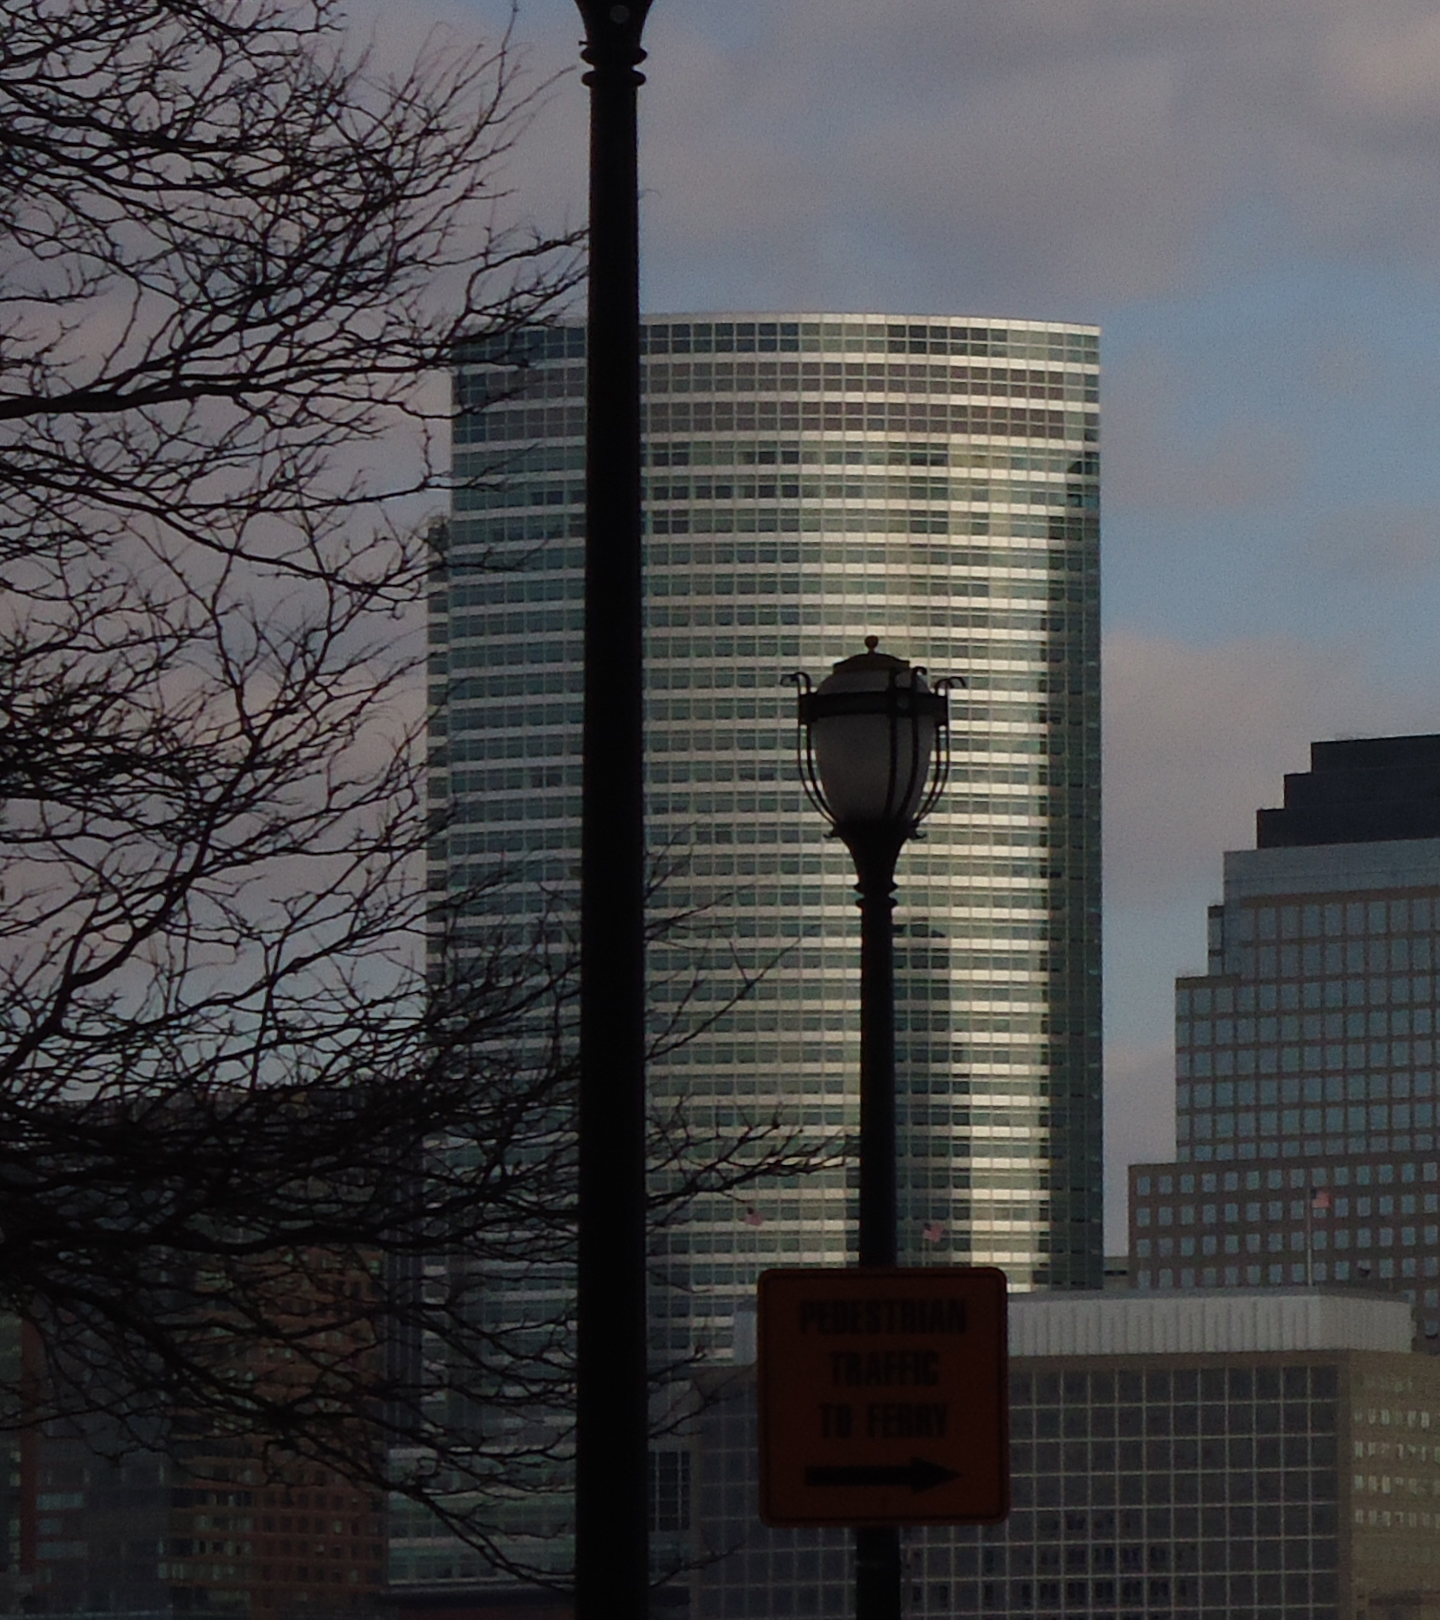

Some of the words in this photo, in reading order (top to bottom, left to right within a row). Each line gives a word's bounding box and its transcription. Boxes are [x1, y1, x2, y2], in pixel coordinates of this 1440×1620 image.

[800, 1298, 967, 1335] PEDESTRIAN
[829, 1350, 939, 1387] TRAFFIC
[819, 1403, 853, 1439] TO
[867, 1403, 948, 1438] FERRY
